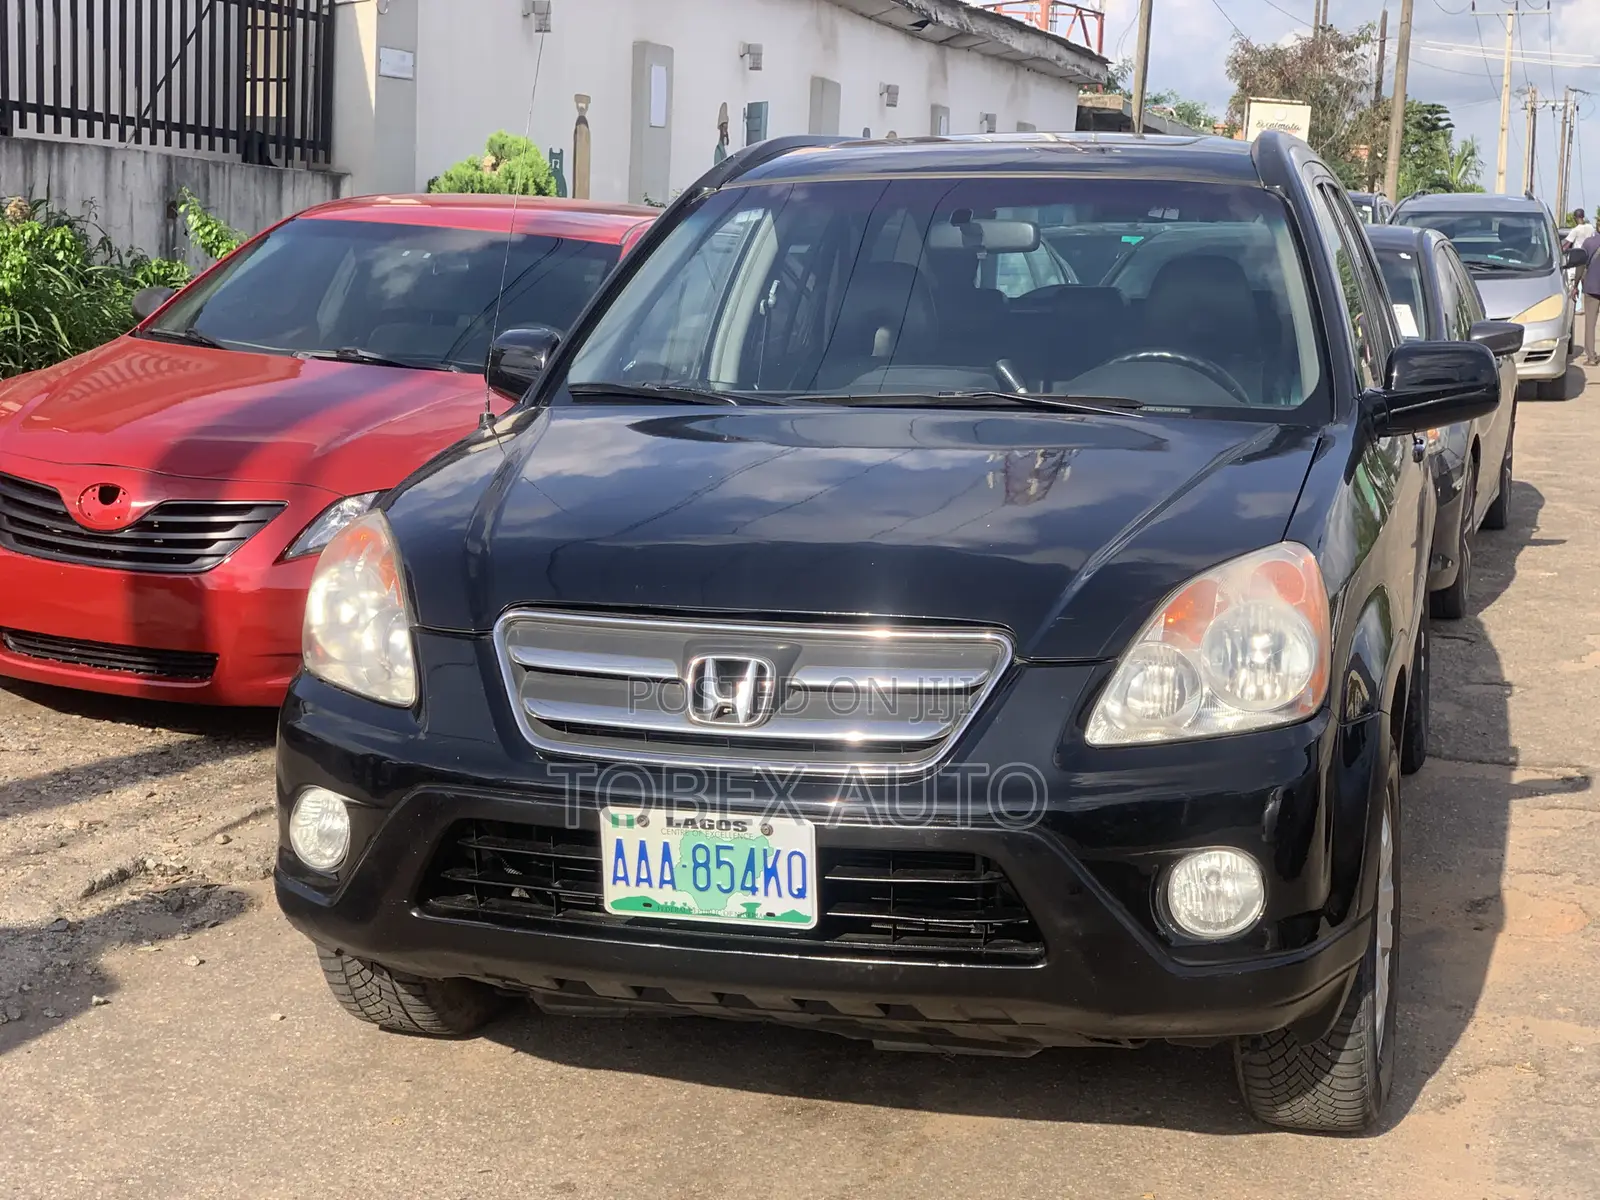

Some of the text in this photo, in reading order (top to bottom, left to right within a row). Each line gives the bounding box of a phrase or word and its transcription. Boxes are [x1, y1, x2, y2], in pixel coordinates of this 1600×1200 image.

[666, 816, 748, 832] LAGOS
[660, 827, 690, 837] CENTRE
[704, 831, 754, 840] EXCELLENCE
